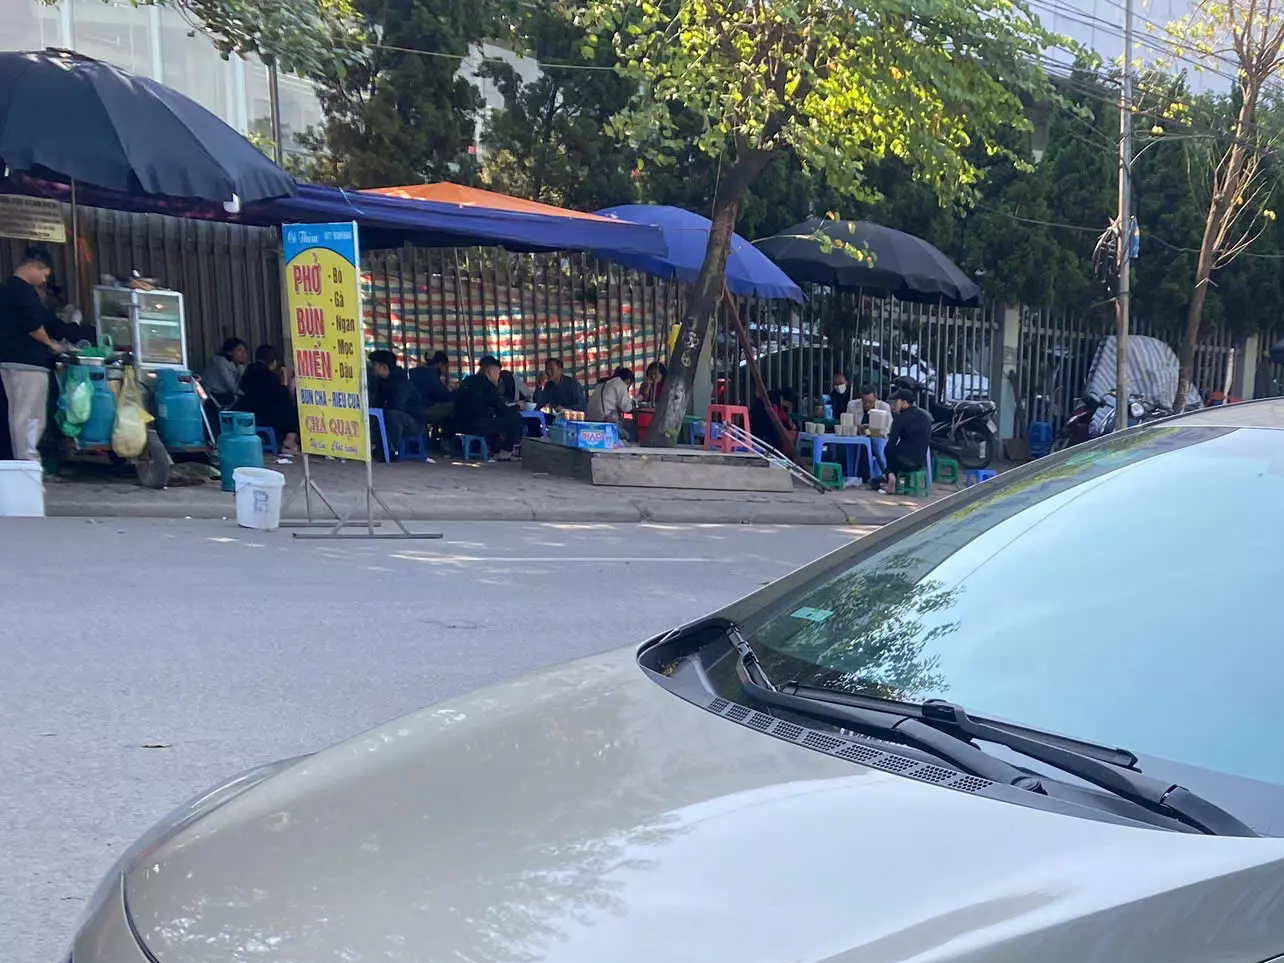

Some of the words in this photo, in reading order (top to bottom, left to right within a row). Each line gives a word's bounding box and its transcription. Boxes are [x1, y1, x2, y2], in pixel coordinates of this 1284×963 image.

[293, 253, 322, 295] PHỞ
[336, 316, 354, 333] Ngan
[338, 339, 353, 359] Mọc
